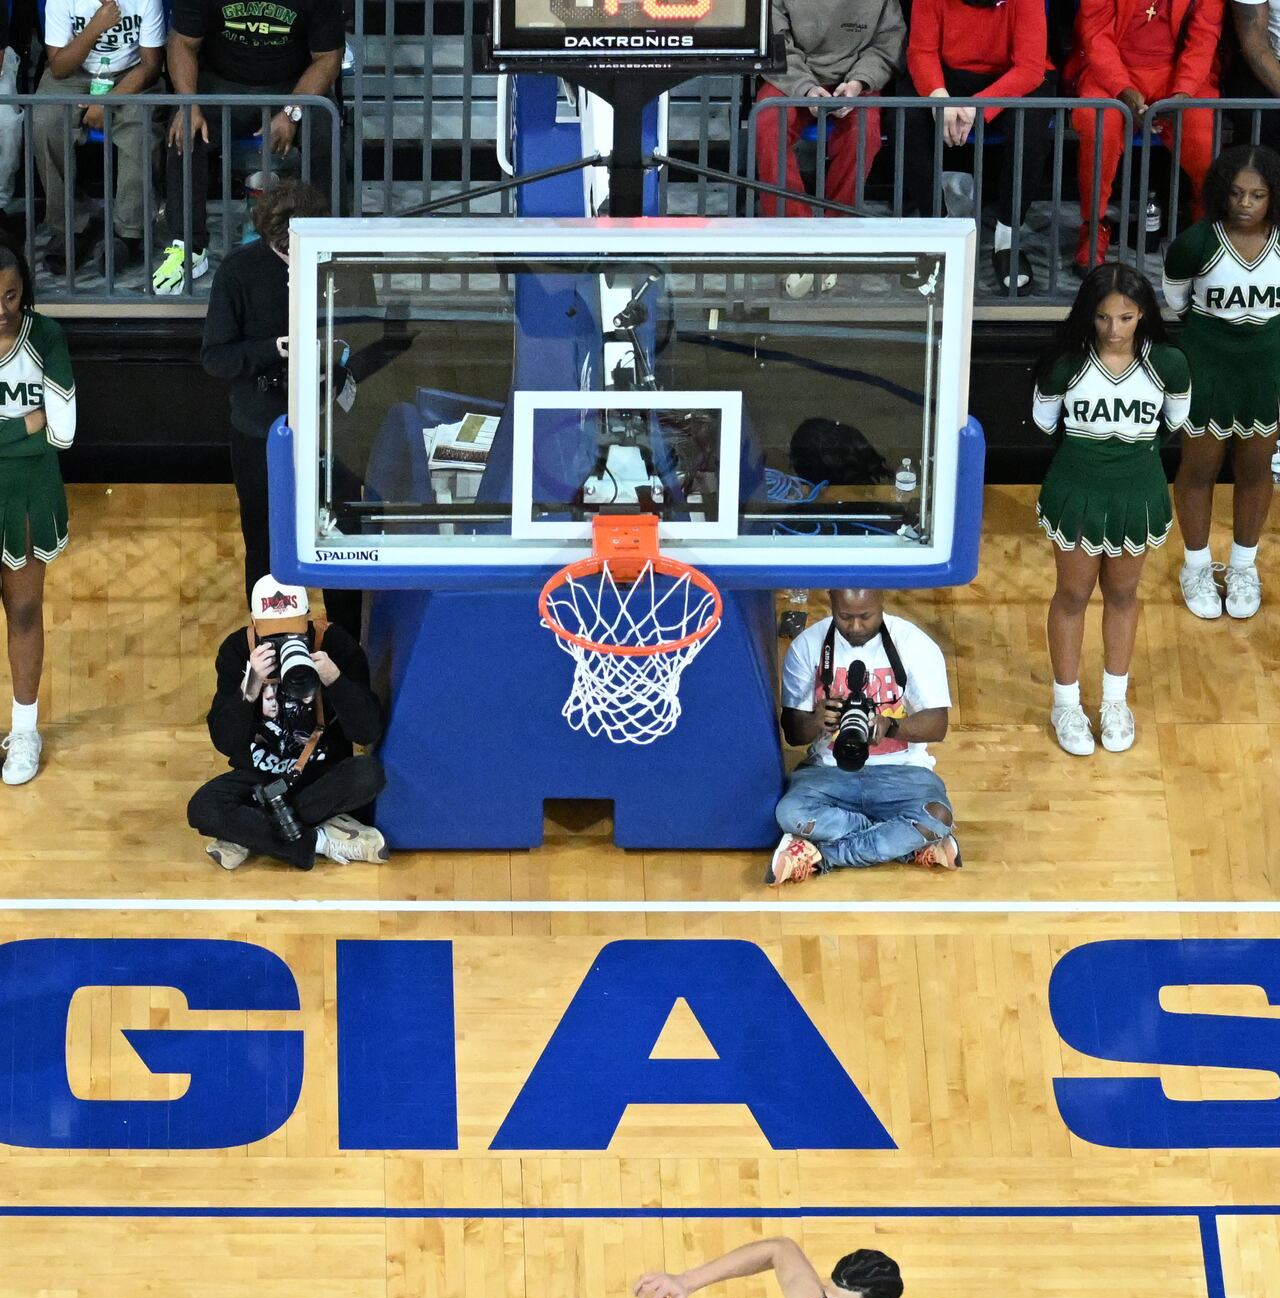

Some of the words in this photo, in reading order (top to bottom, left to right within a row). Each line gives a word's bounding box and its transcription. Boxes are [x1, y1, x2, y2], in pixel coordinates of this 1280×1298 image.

[222, 2, 298, 25] GRAYSON
[247, 22, 270, 34] VS
[564, 36, 694, 47] DAKTRONICS
[1074, 398, 1156, 424] RAMS
[315, 550, 379, 562] SPALDING
[261, 595, 298, 613] BRS
